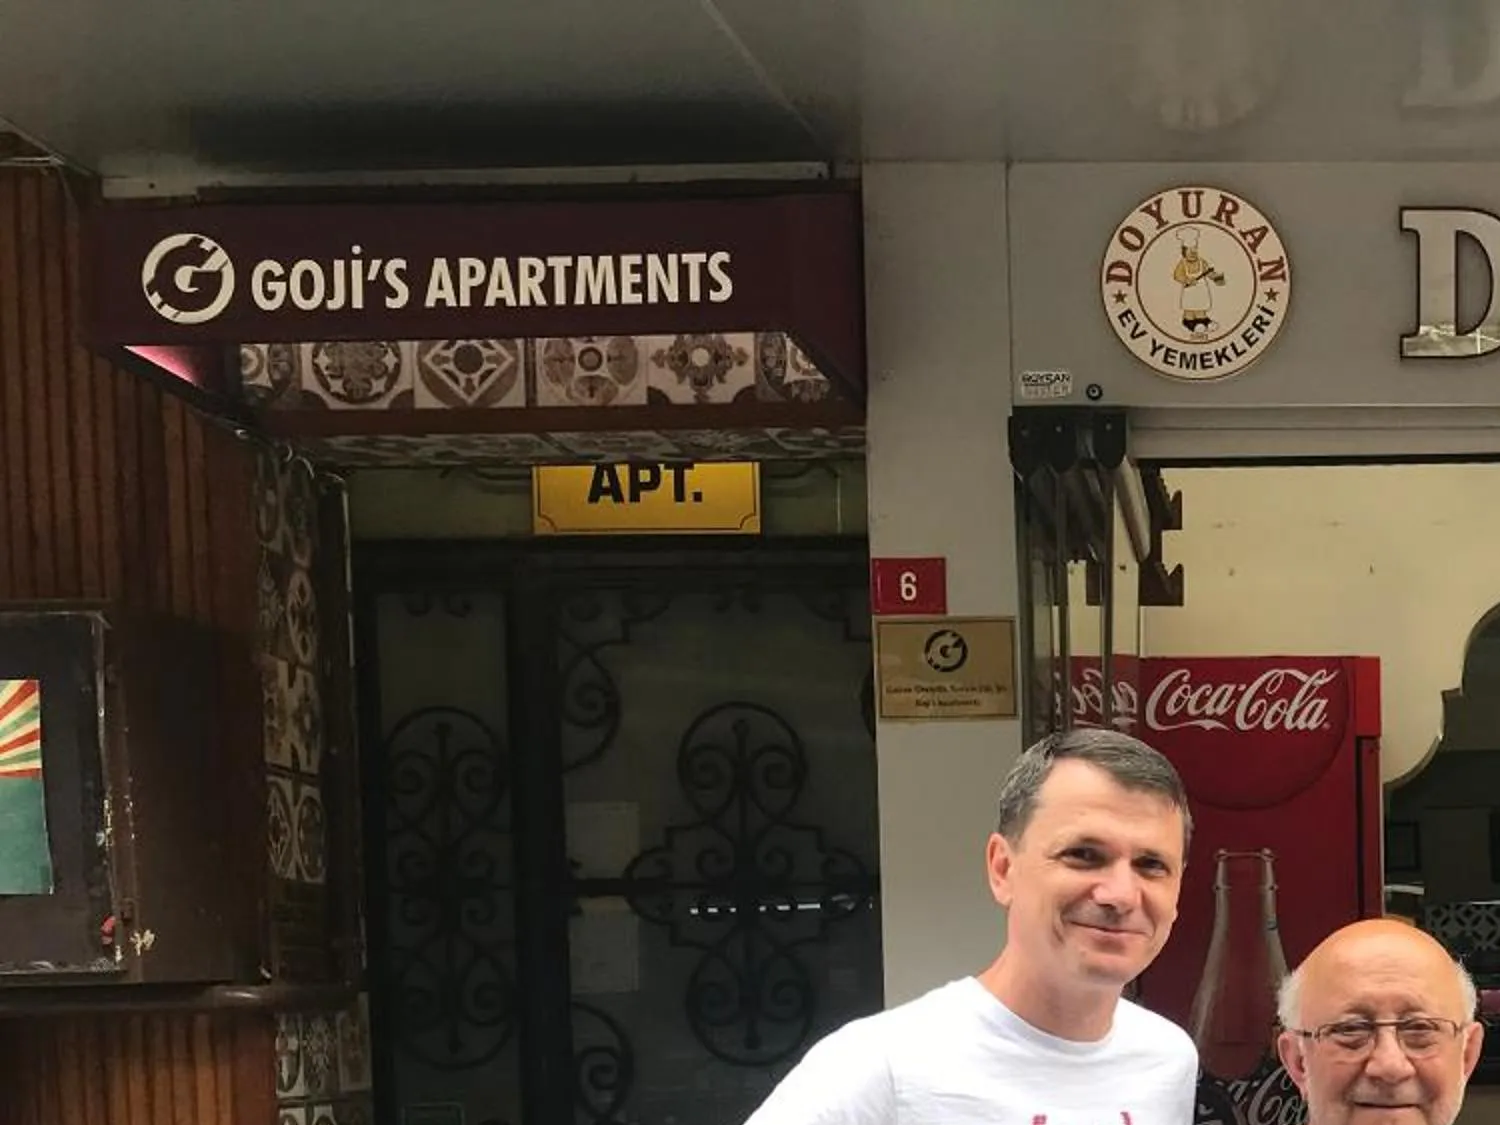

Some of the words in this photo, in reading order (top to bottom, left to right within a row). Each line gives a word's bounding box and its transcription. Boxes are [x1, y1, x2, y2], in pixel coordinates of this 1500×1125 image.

[1105, 190, 1287, 287] DOYURAN
[424, 251, 734, 309] APARTMENTS
[1117, 307, 1147, 341] EV
[587, 462, 703, 503] APT.
[899, 571, 917, 601] 6
[1145, 669, 1340, 732] Coca-Cola
